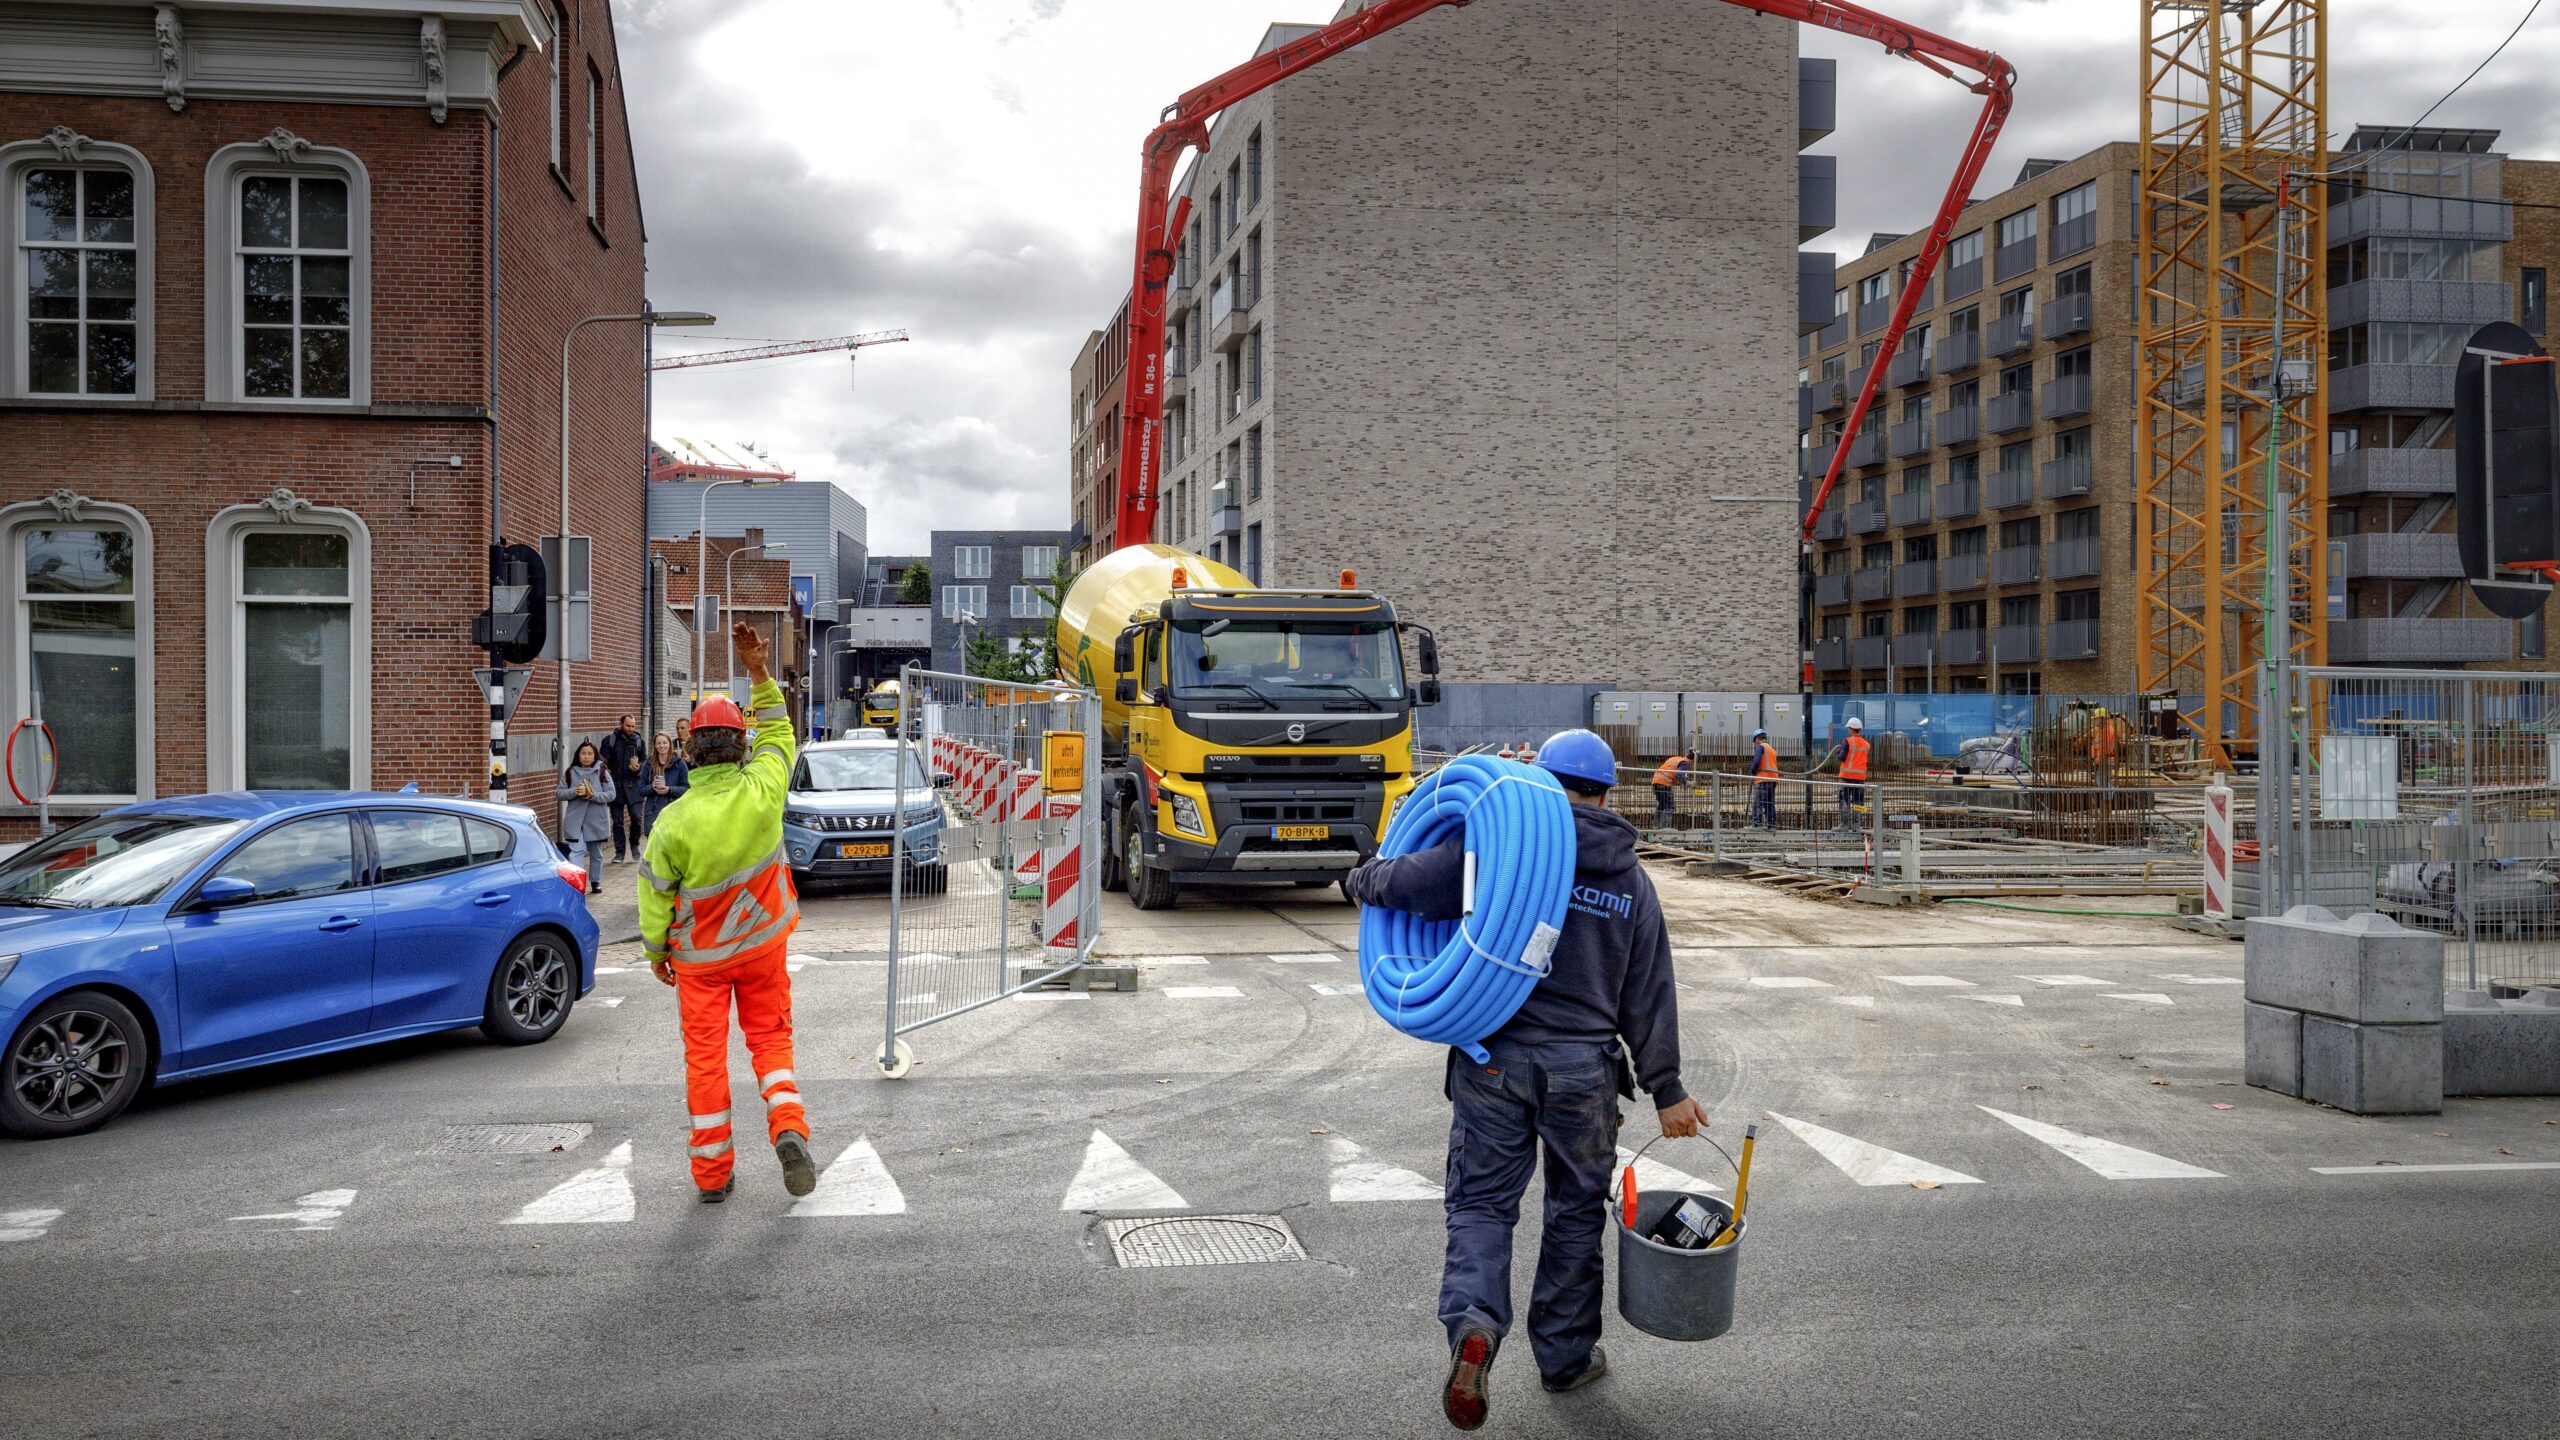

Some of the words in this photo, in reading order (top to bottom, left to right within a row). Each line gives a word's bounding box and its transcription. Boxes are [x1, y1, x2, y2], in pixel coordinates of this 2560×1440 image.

[1146, 353, 1157, 381] 36-4
[1145, 383, 1154, 394] M
[1136, 417, 1152, 511] Putzmeister
[1279, 827, 1325, 837] 70-BPK-8
